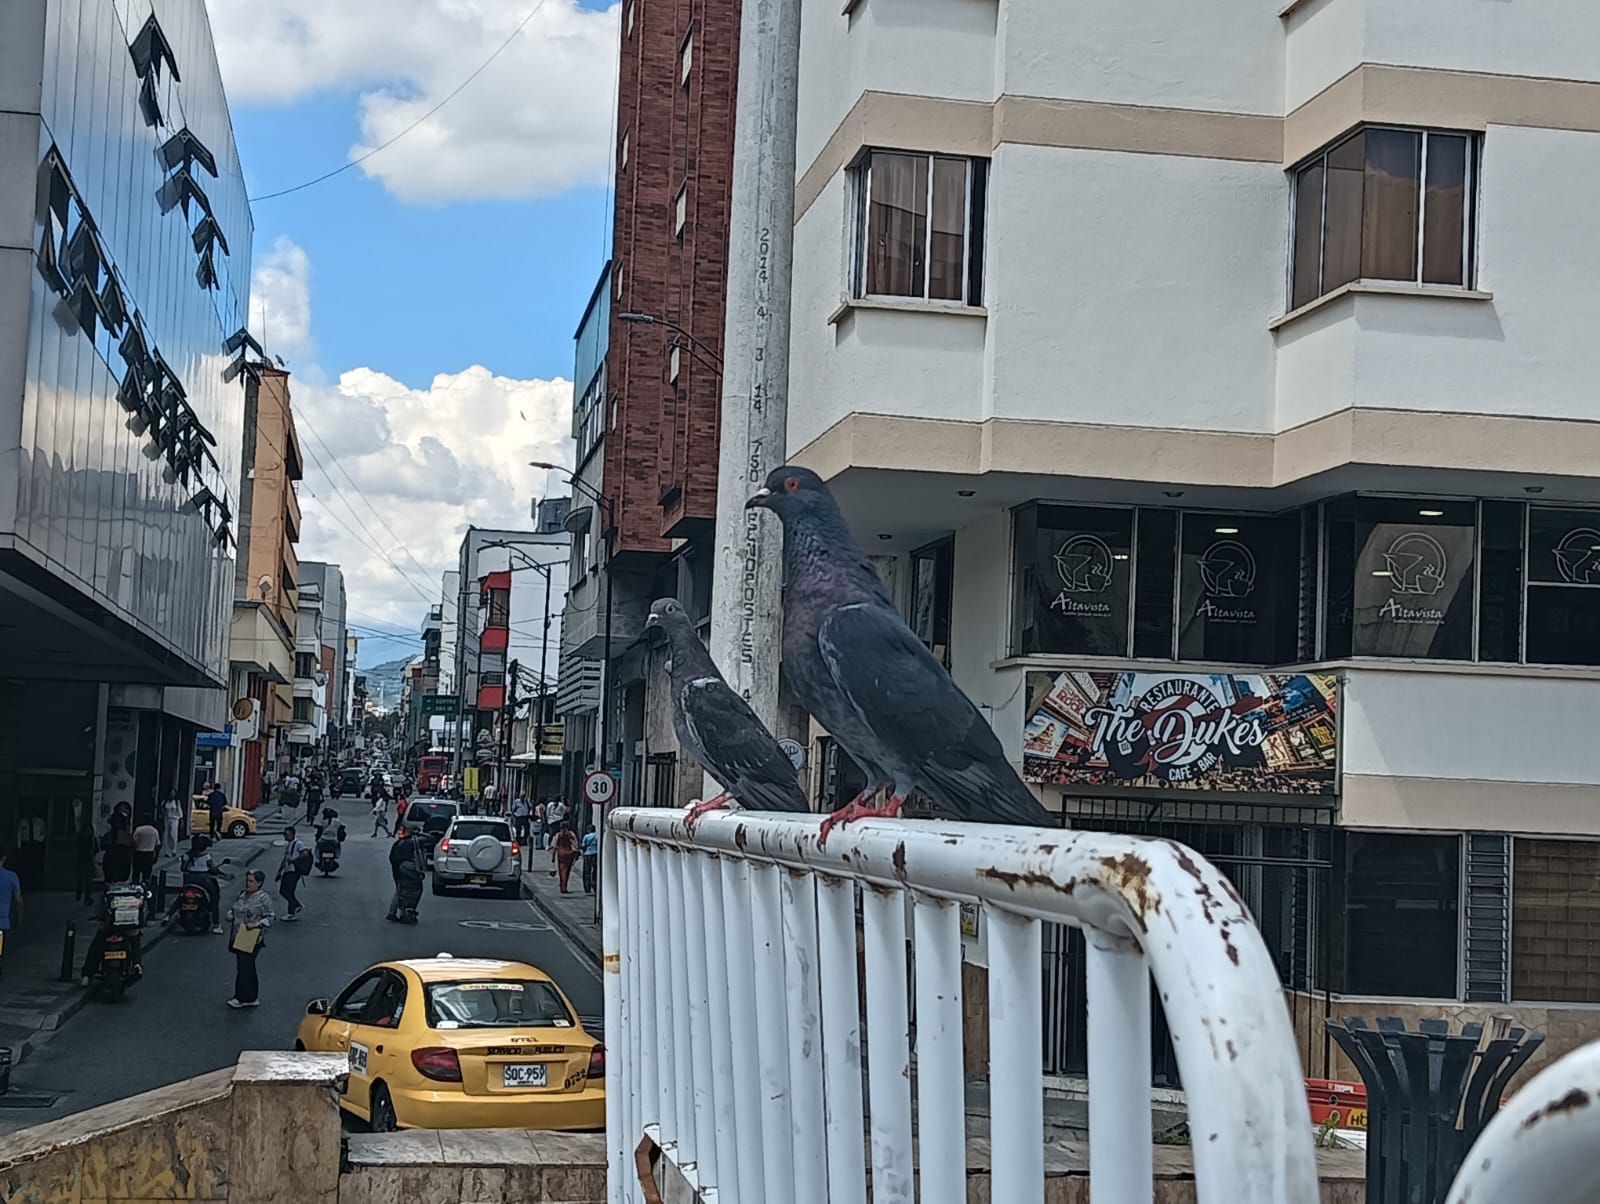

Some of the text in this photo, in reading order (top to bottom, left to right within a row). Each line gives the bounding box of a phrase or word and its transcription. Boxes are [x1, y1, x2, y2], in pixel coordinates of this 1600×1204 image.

[759, 227, 769, 283] 2014
[1140, 679, 1220, 714] RESTAURANTE
[1084, 704, 1268, 764] The Dukes
[1197, 752, 1217, 772] BAR
[592, 781, 608, 794] 30
